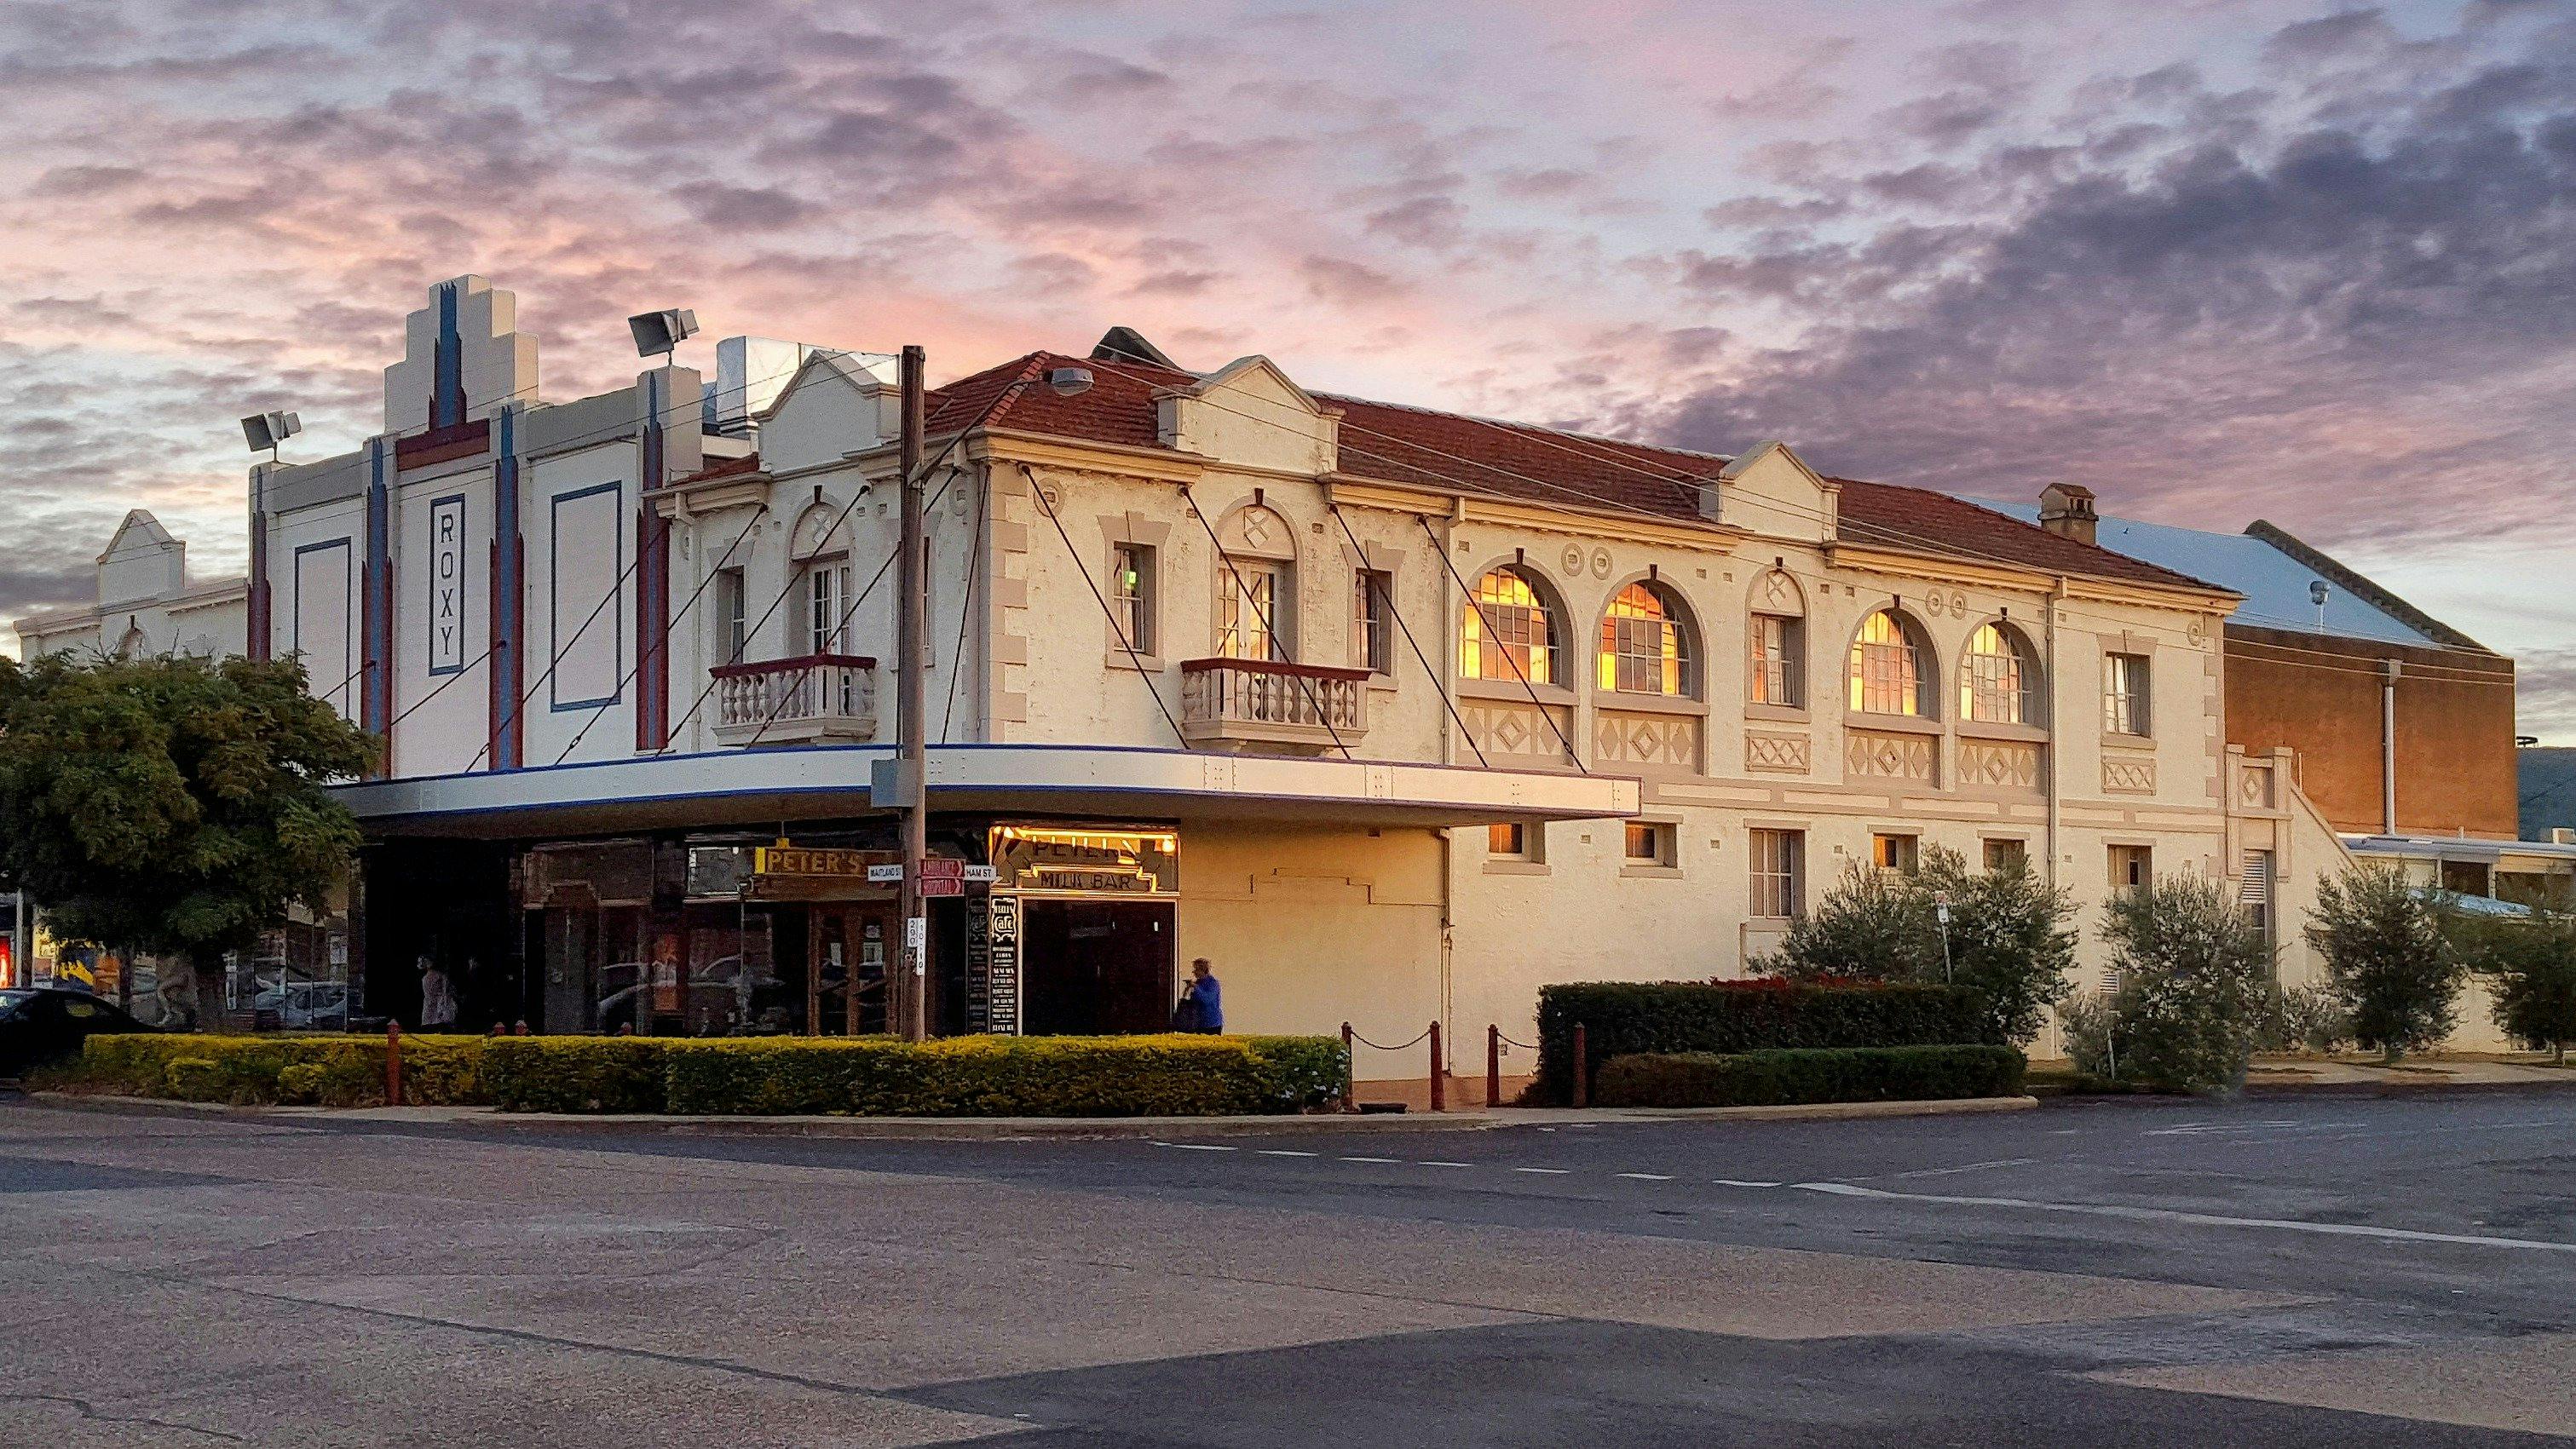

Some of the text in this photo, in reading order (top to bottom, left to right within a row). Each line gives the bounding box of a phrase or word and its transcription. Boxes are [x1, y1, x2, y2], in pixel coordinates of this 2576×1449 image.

[440, 513, 455, 656] ROXY
[767, 850, 865, 876] PETER'S
[983, 868, 992, 878] ST
[1040, 872, 1132, 891] MILK BAR
